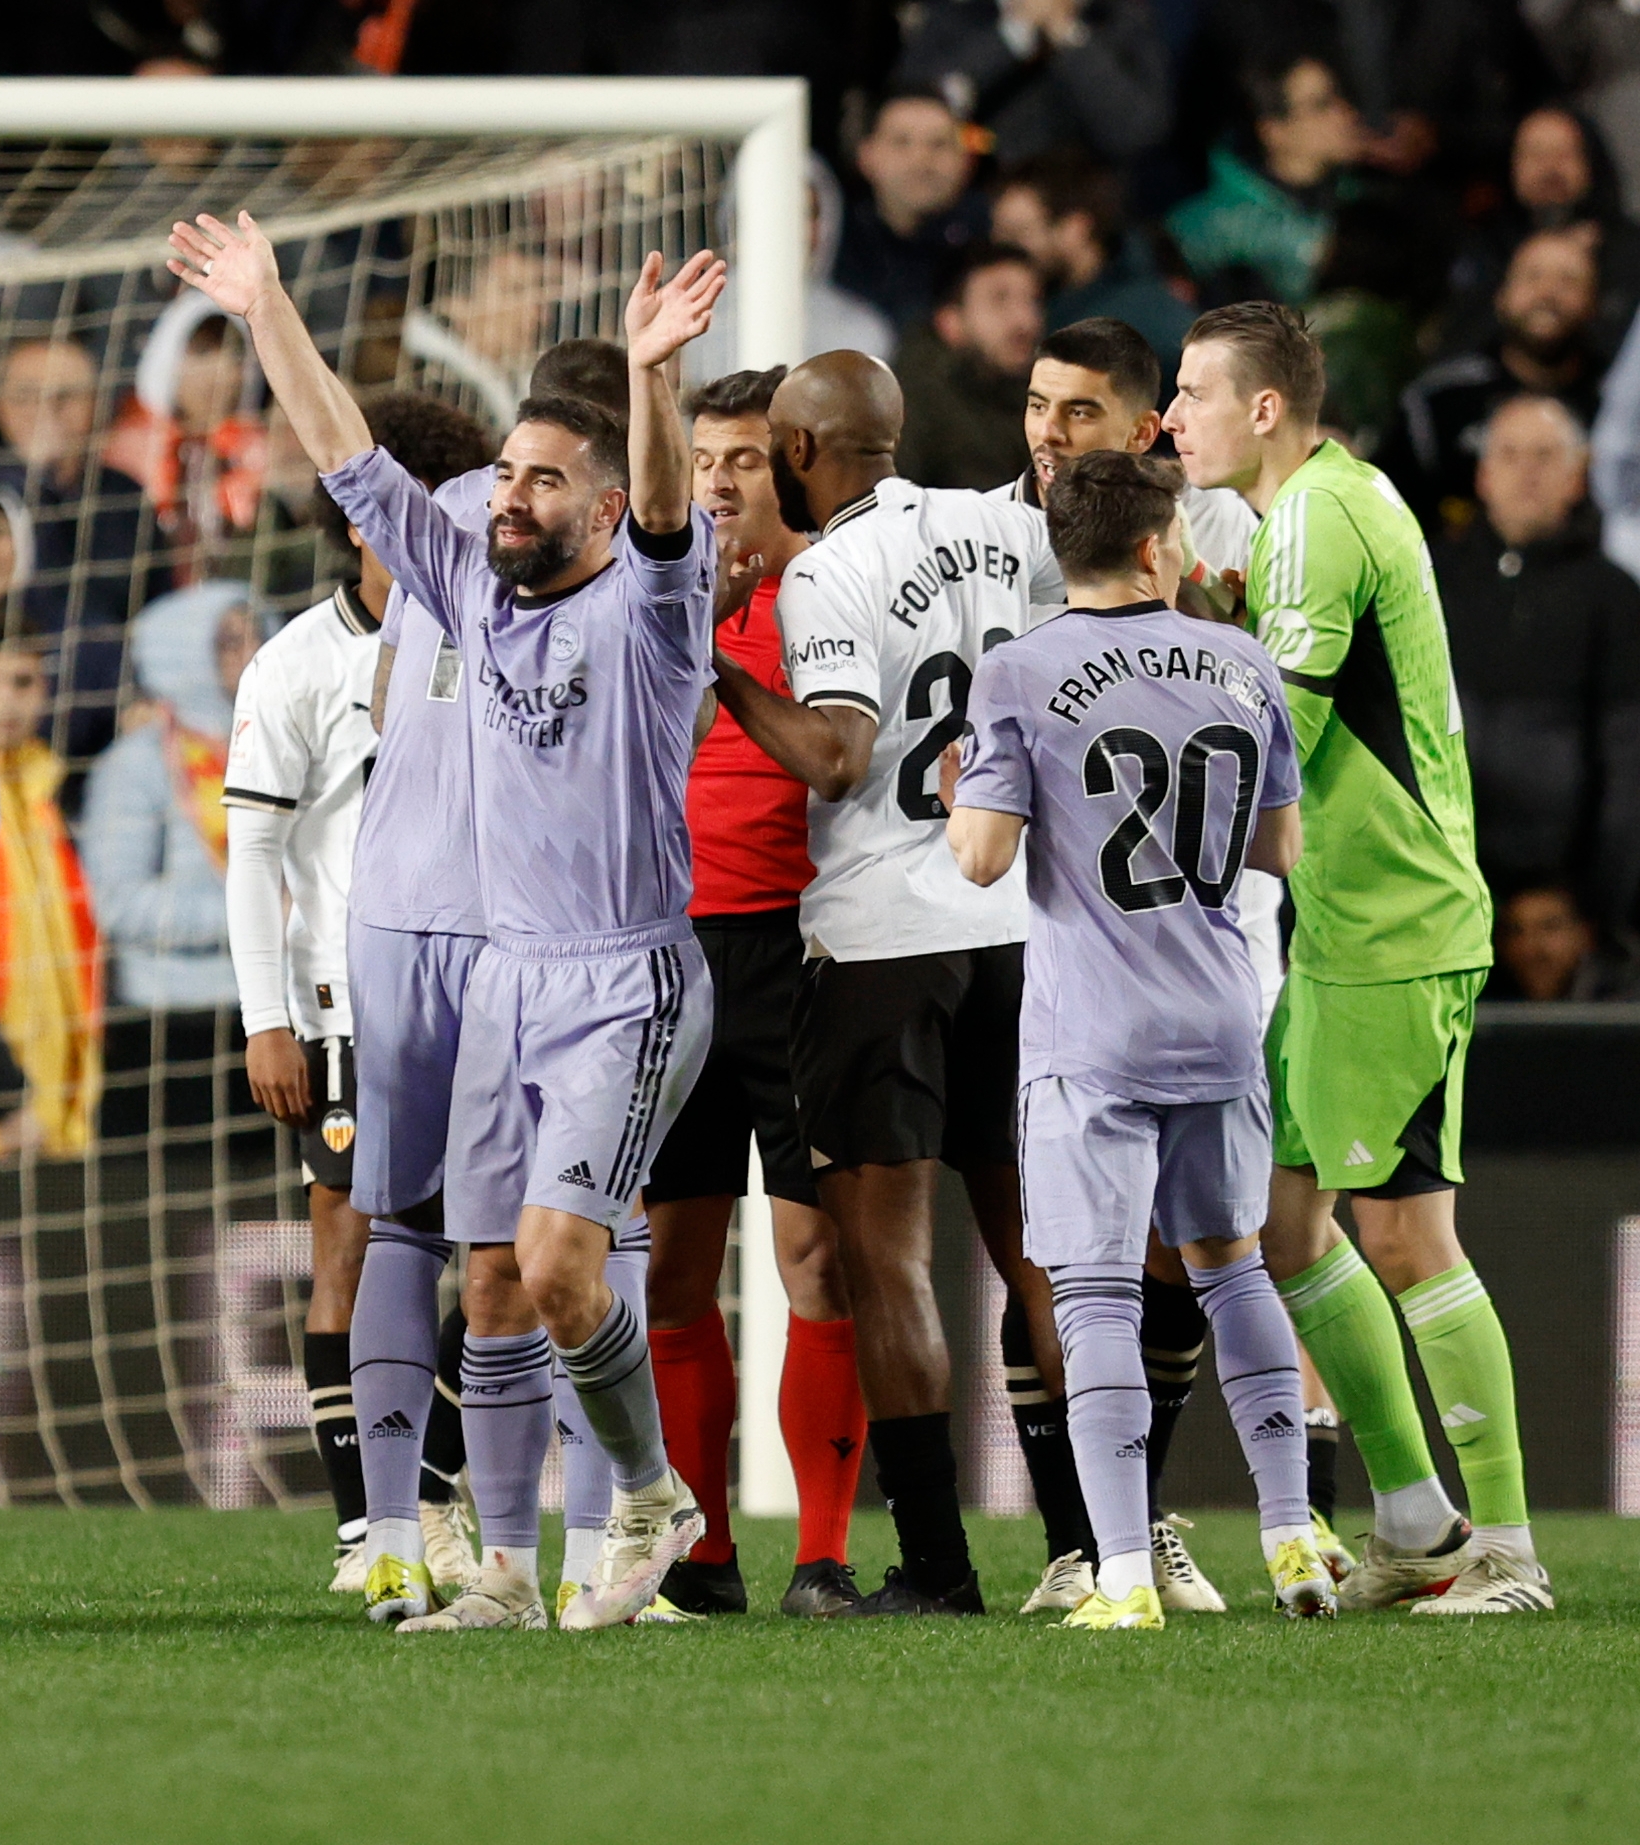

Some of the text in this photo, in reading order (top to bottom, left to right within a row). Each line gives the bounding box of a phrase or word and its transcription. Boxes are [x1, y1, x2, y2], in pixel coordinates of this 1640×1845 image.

[1045, 646, 1268, 727] FRAN GARCÍA
[1081, 722, 1260, 915] 20
[557, 1172, 596, 1191] adidas
[367, 1428, 418, 1441] adidas
[1250, 1426, 1303, 1442] adidas
